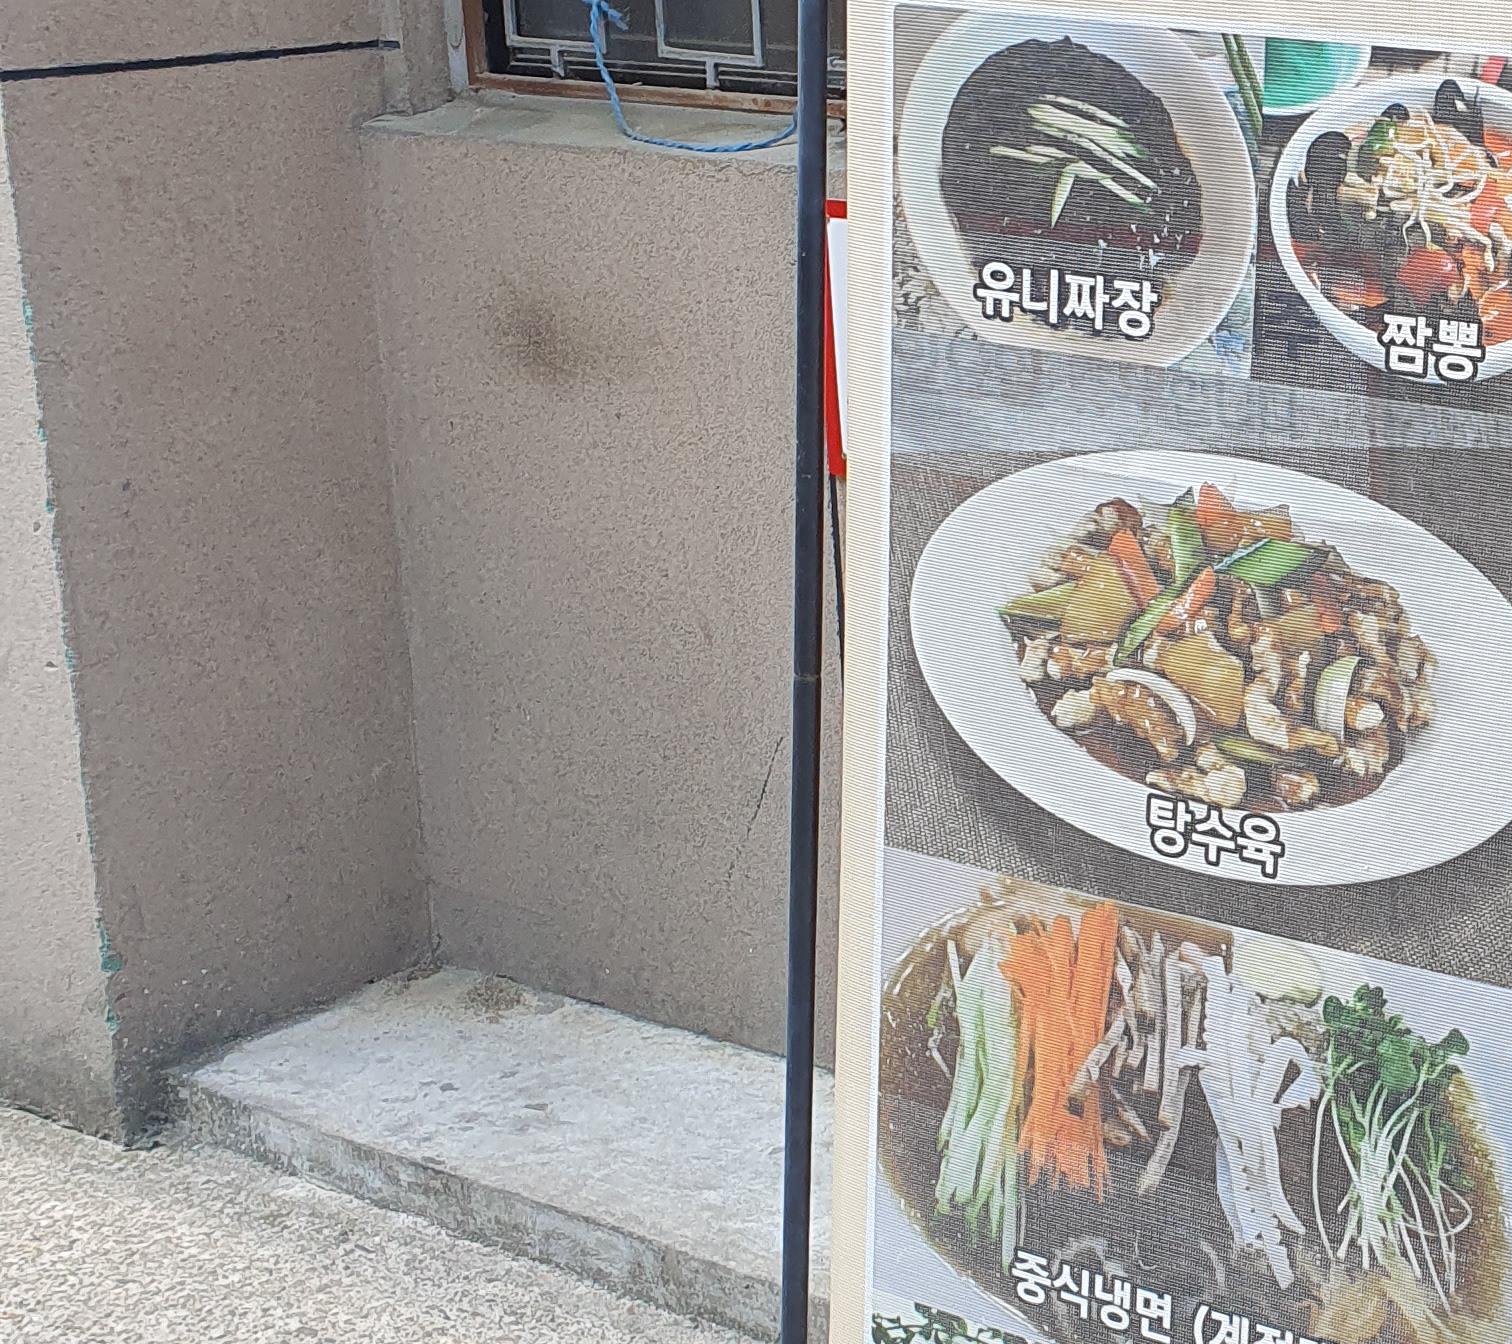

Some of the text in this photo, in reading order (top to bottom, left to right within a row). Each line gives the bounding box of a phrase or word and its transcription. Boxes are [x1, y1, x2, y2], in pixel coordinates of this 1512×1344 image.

[975, 261, 1159, 338] 유니짜장
[1381, 312, 1483, 381] 짬뽕
[1149, 797, 1284, 880] 탕수육
[1011, 1250, 1174, 1344] 중식냉면
